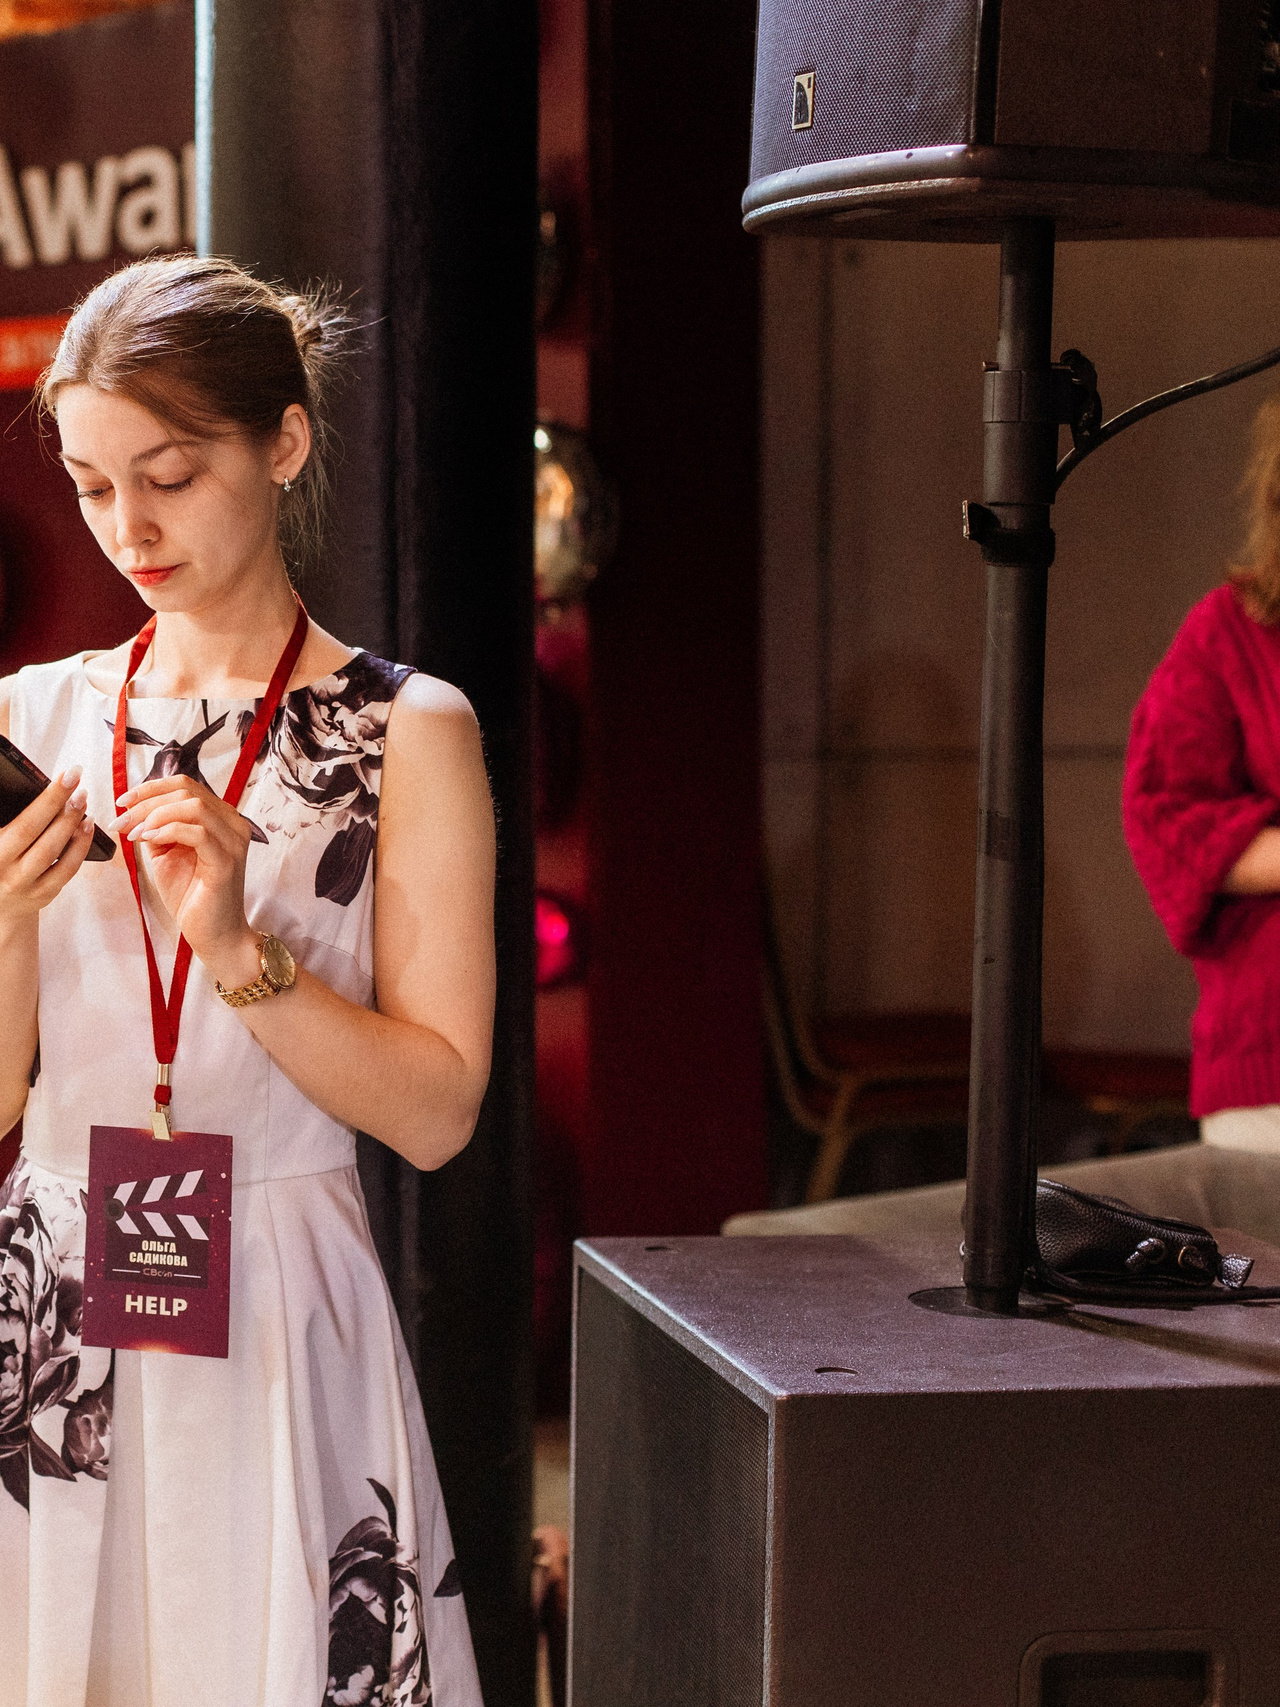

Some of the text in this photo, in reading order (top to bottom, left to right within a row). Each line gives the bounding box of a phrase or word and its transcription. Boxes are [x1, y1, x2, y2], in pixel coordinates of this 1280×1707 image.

[141, 1240, 177, 1253] ОЛЬГА
[129, 1251, 188, 1267] САДИКОВА
[125, 1294, 188, 1317] HELP
